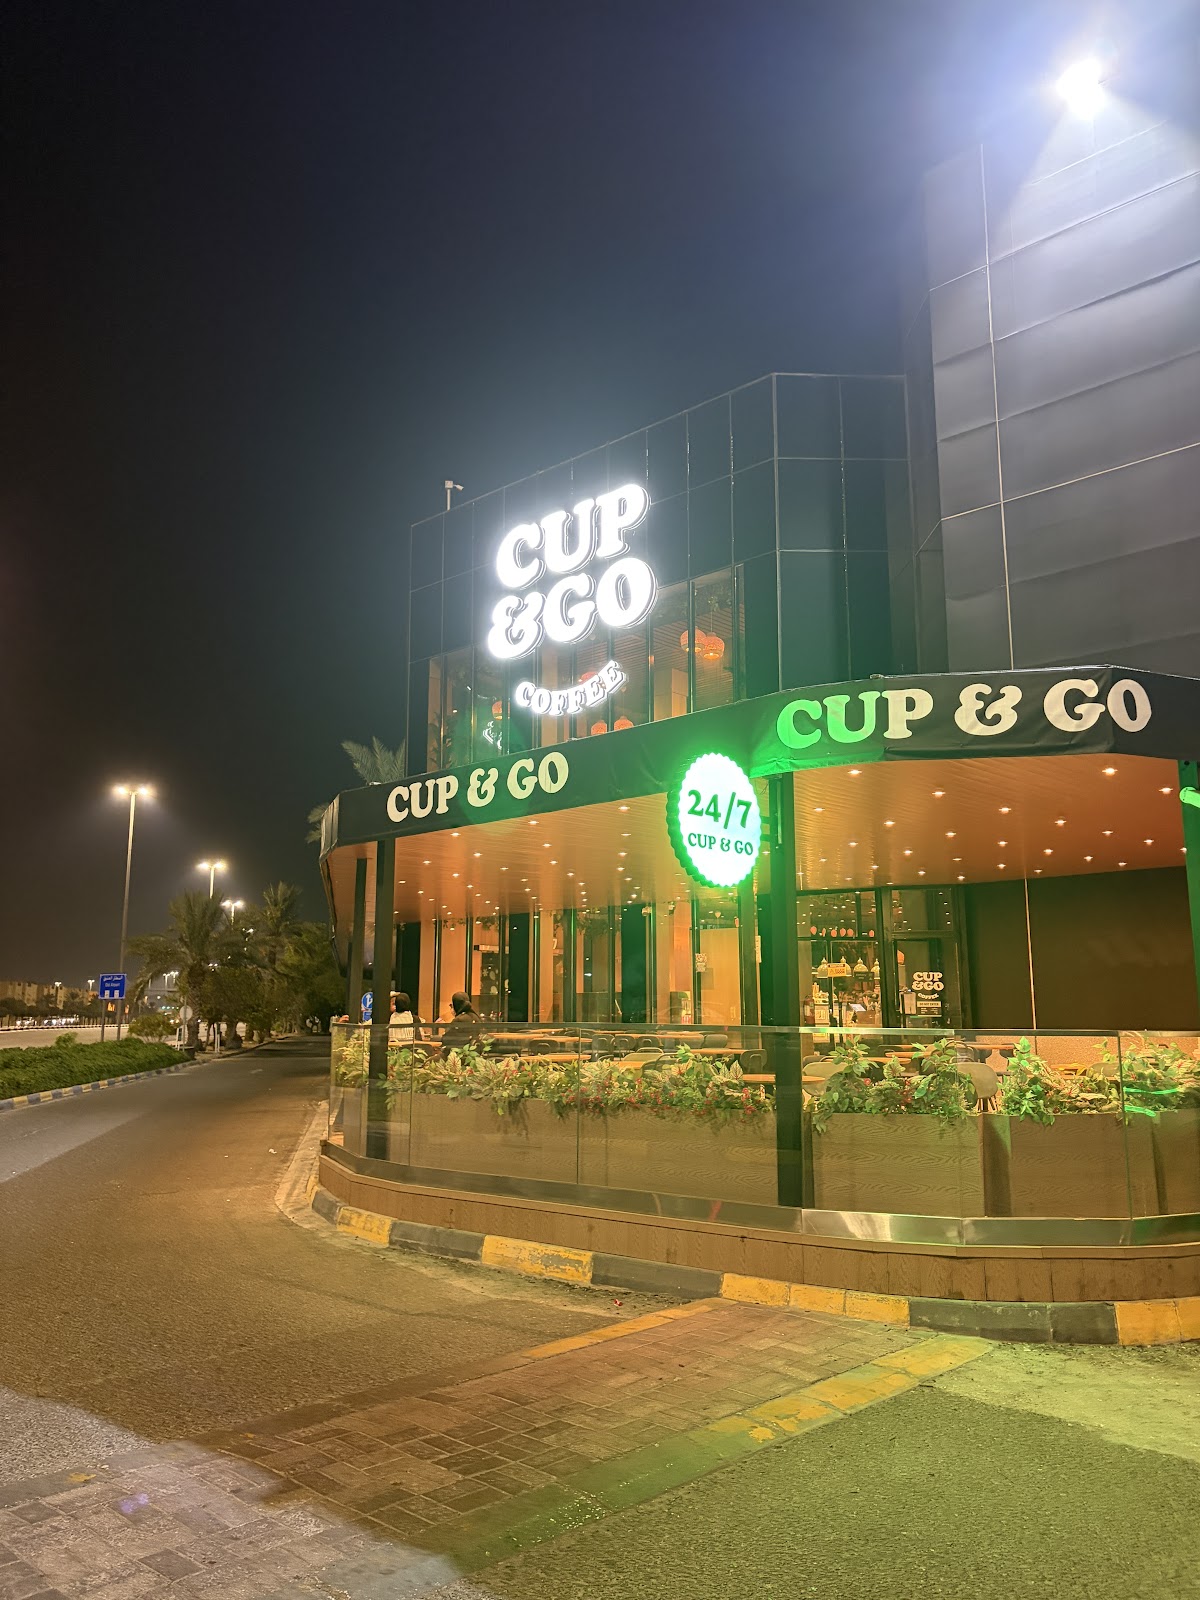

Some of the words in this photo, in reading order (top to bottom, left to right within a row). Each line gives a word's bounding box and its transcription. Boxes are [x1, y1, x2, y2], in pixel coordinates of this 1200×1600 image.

[496, 483, 650, 590] CUP
[516, 660, 628, 715] COFFEE
[776, 688, 934, 749] CUP
[954, 683, 1023, 736] &
[1043, 679, 1152, 732] GO
[386, 775, 459, 823] CUP
[467, 767, 499, 807] &
[506, 751, 569, 800] GO
[687, 789, 752, 829] 24/7
[687, 832, 716, 849] CUP
[720, 837, 731, 852] &
[734, 840, 754, 856] GO
[913, 971, 943, 981] CUP
